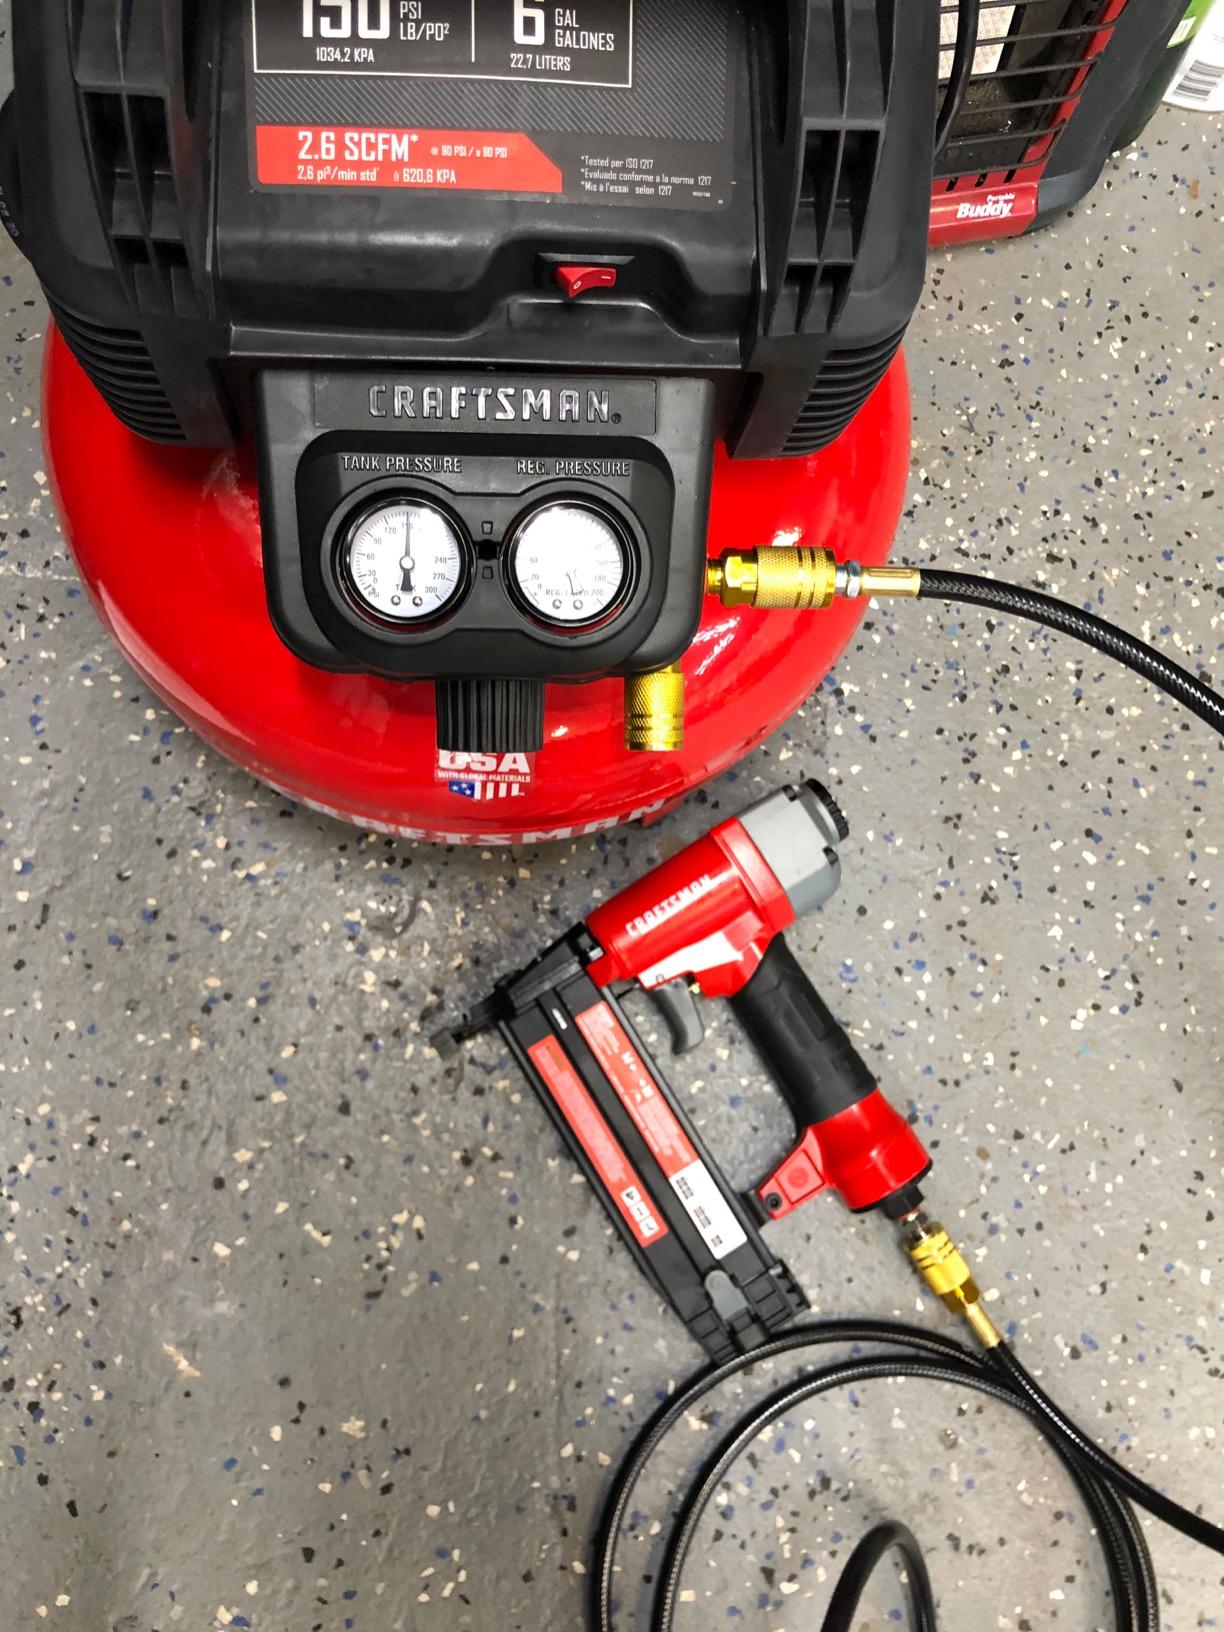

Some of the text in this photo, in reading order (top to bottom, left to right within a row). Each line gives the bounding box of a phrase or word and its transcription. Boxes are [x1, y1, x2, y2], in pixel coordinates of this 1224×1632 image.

[400, 1, 422, 19] PSI
[555, 8, 580, 27] GAL
[302, 0, 390, 39] 150
[513, 0, 545, 45] 6
[555, 29, 615, 51] GALONES
[354, 48, 375, 63] KPA
[535, 55, 571, 71] LITERS
[297, 131, 336, 160] 2.6
[441, 145, 453, 157] 90
[454, 145, 467, 157] PSI
[482, 146, 493, 158] 90
[495, 147, 508, 159] PSI
[610, 159, 624, 169] per
[625, 158, 638, 169] ISO
[639, 159, 654, 170] 1217
[436, 169, 457, 184] KPA
[619, 170, 654, 182] conforme
[662, 174, 669, 184] la
[670, 176, 695, 186] norma
[698, 175, 712, 187] 1217
[635, 185, 655, 196] selon
[658, 185, 673, 197] 1217
[341, 455, 463, 474] TANK PRESSURE
[516, 459, 631, 477] REG. PRESSURE
[384, 526, 397, 535] 120
[373, 537, 383, 545] 90
[434, 556, 448, 564] 240
[367, 569, 377, 577] 30
[433, 572, 446, 580] 270
[424, 585, 438, 594] 300
[438, 749, 531, 774] USA
[436, 770, 531, 783] WITH GLOBAL MATERIALS
